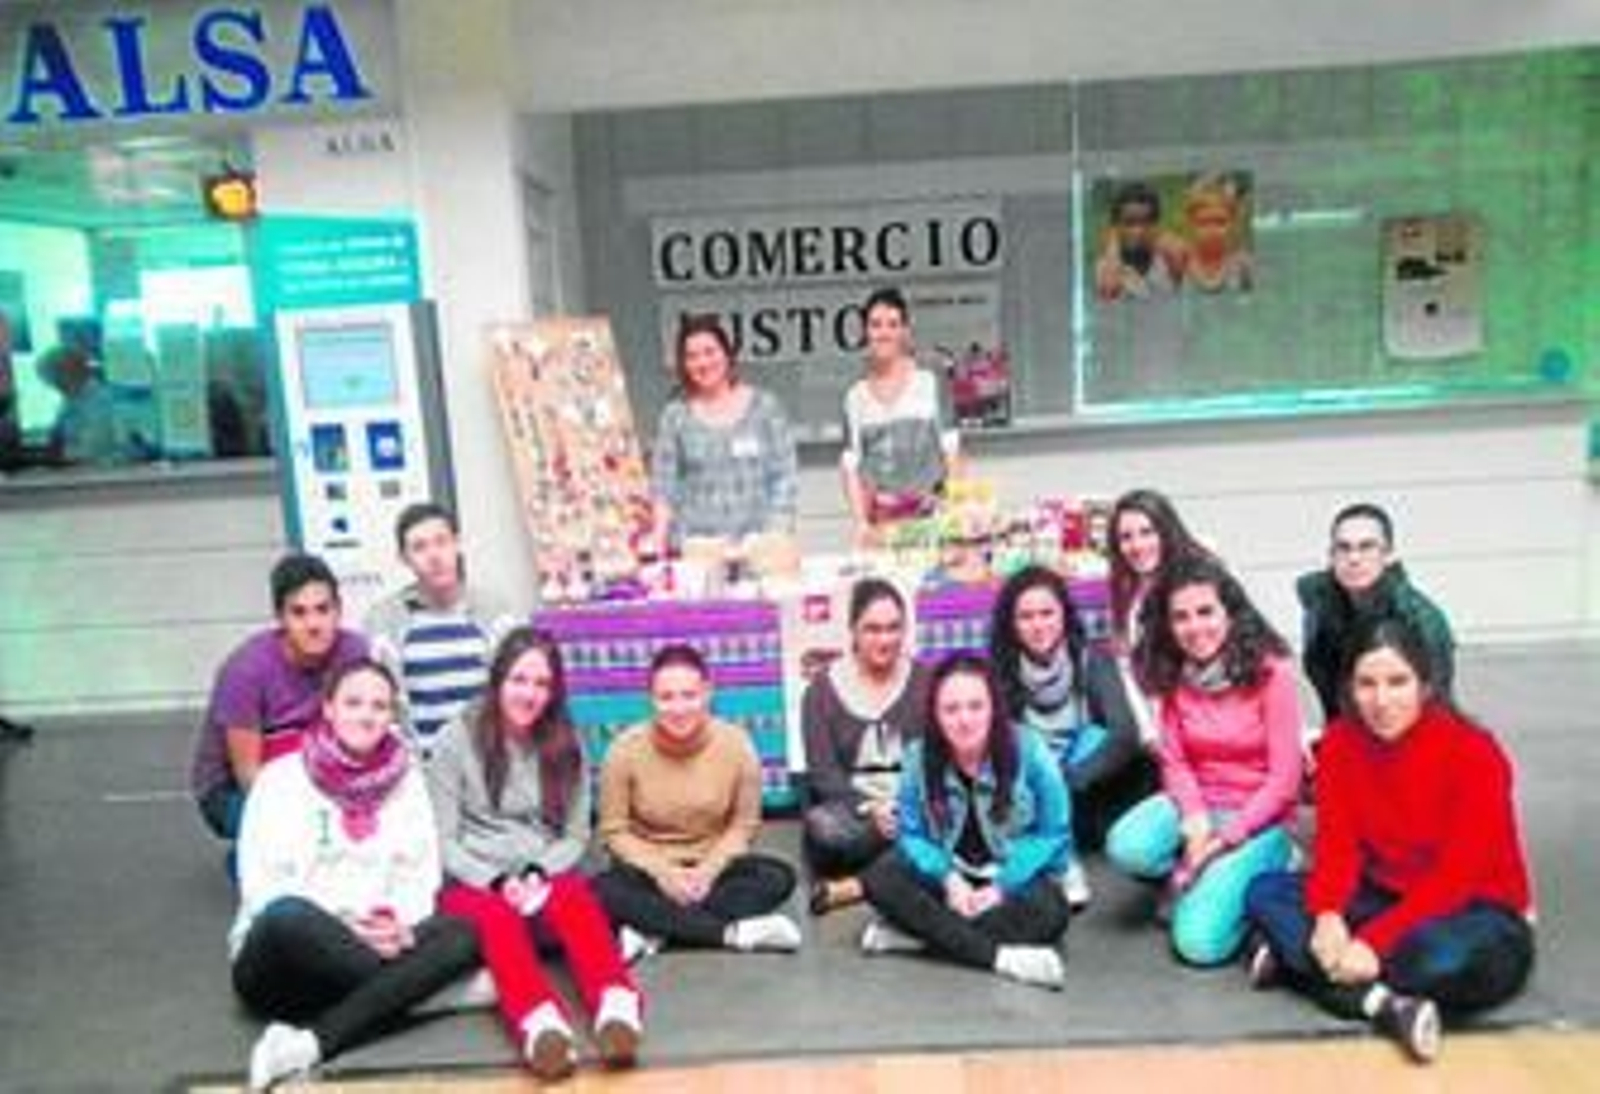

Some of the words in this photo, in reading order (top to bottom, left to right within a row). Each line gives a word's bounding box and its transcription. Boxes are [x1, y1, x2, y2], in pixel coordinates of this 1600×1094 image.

[7, 3, 373, 122] ALSA
[660, 216, 999, 281] COMERCIO
[681, 303, 868, 357] STO
